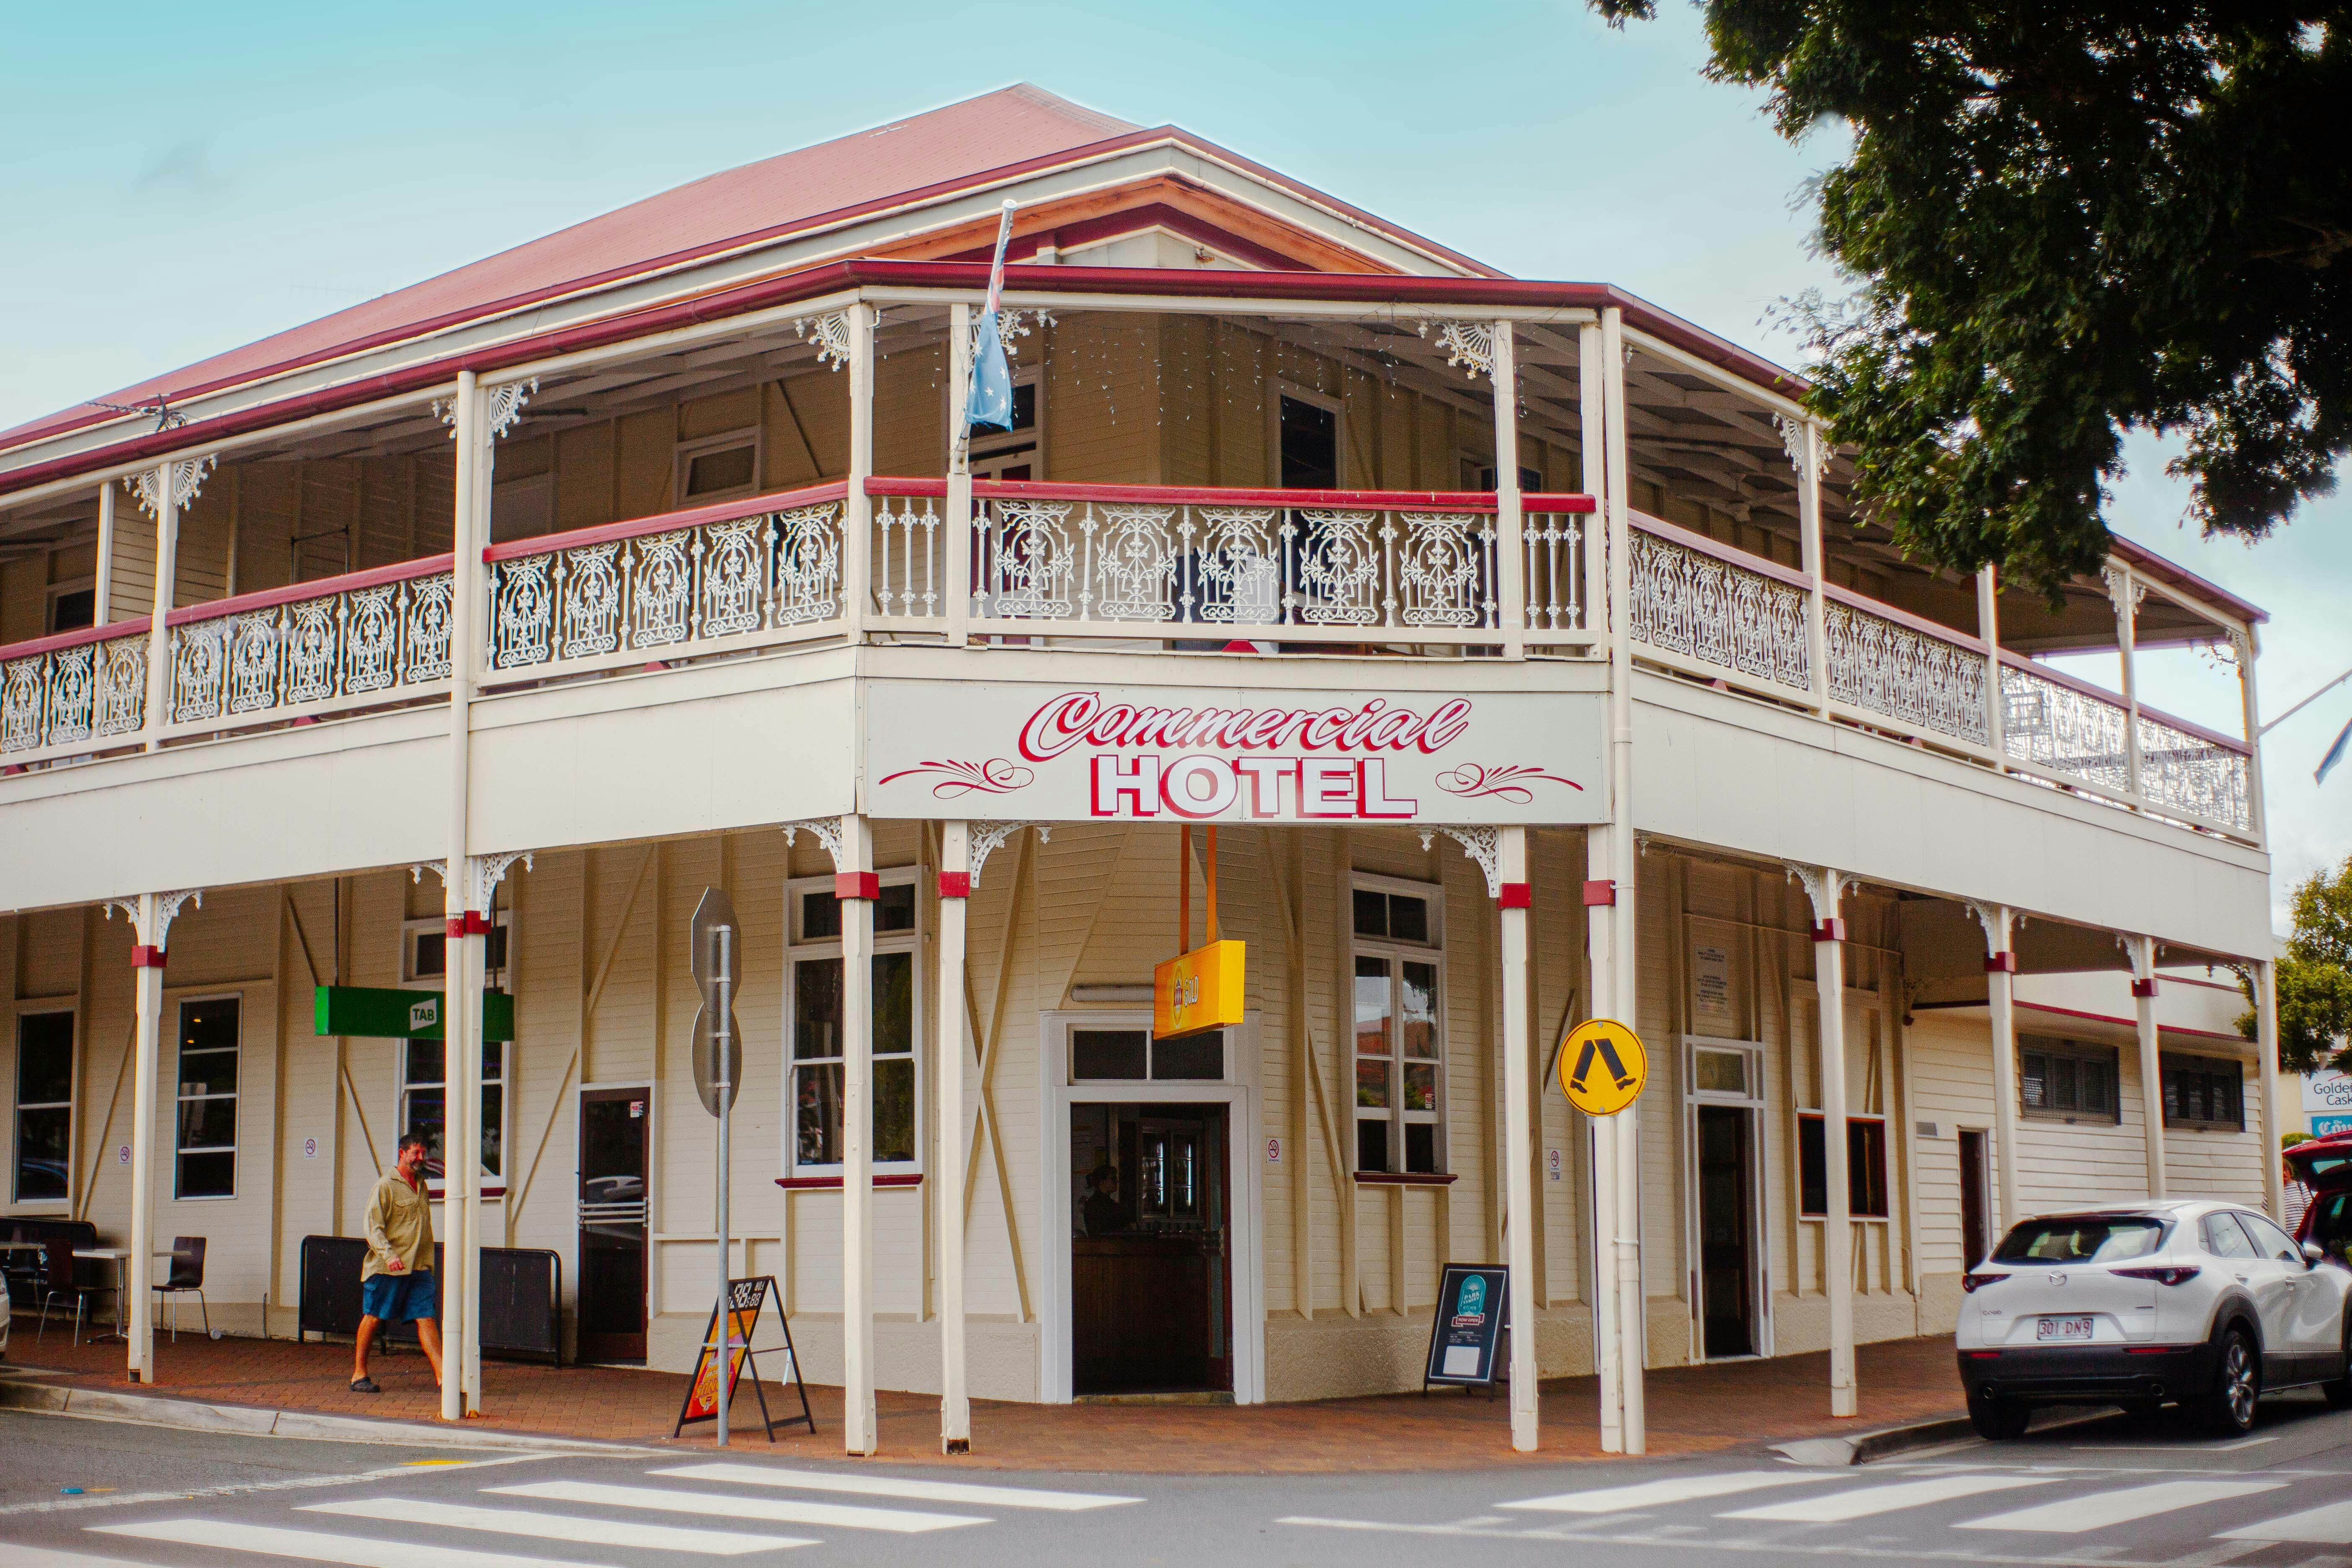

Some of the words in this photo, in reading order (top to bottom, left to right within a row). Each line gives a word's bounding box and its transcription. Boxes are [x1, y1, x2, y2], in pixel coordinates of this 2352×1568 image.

[1018, 691, 1472, 763] Commercial
[1091, 753, 1417, 818] HOTEL
[1184, 975, 1199, 1008] GOLD
[413, 1008, 434, 1021] TAB
[2314, 1082, 2352, 1094] Golde
[2066, 1321, 2090, 1333] DN9
